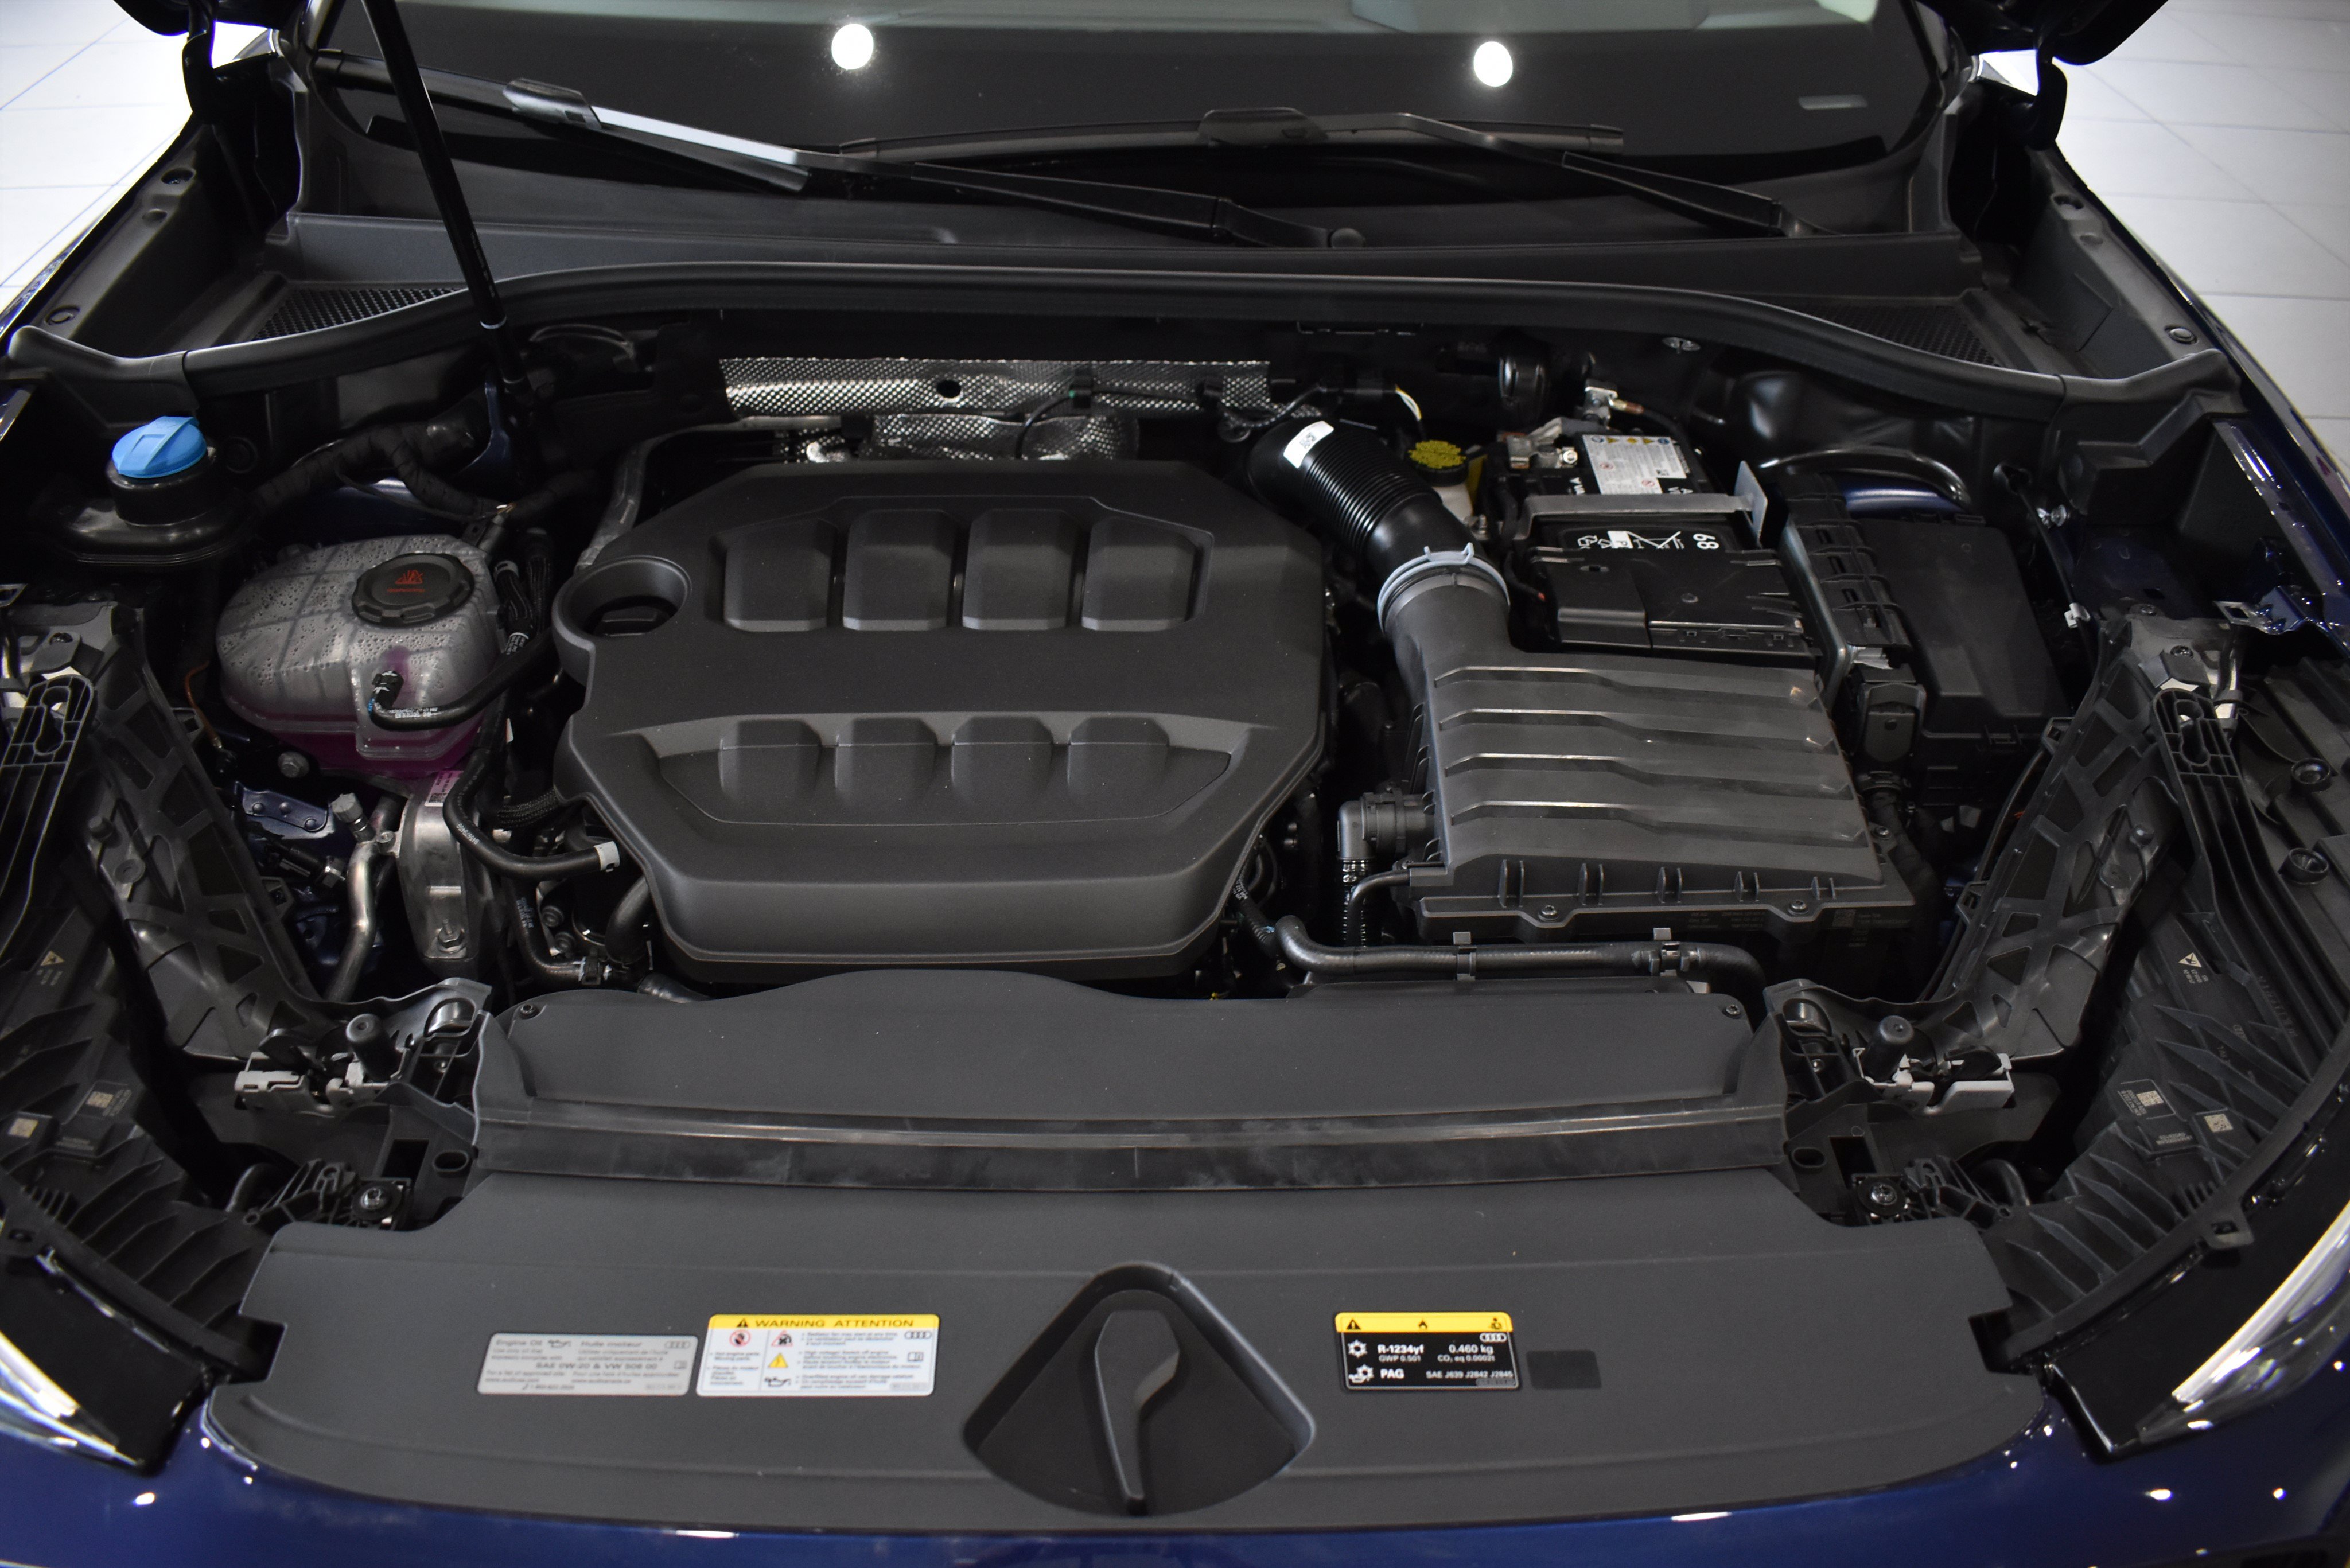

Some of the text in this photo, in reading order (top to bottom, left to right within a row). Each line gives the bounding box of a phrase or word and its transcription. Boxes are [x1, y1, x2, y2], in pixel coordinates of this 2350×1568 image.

[1378, 1344, 1425, 1355] R-1234yf
[1449, 1344, 1494, 1355] 0.460 kg
[1380, 1368, 1404, 1378] PAG
[1426, 1370, 1442, 1378] SAE
